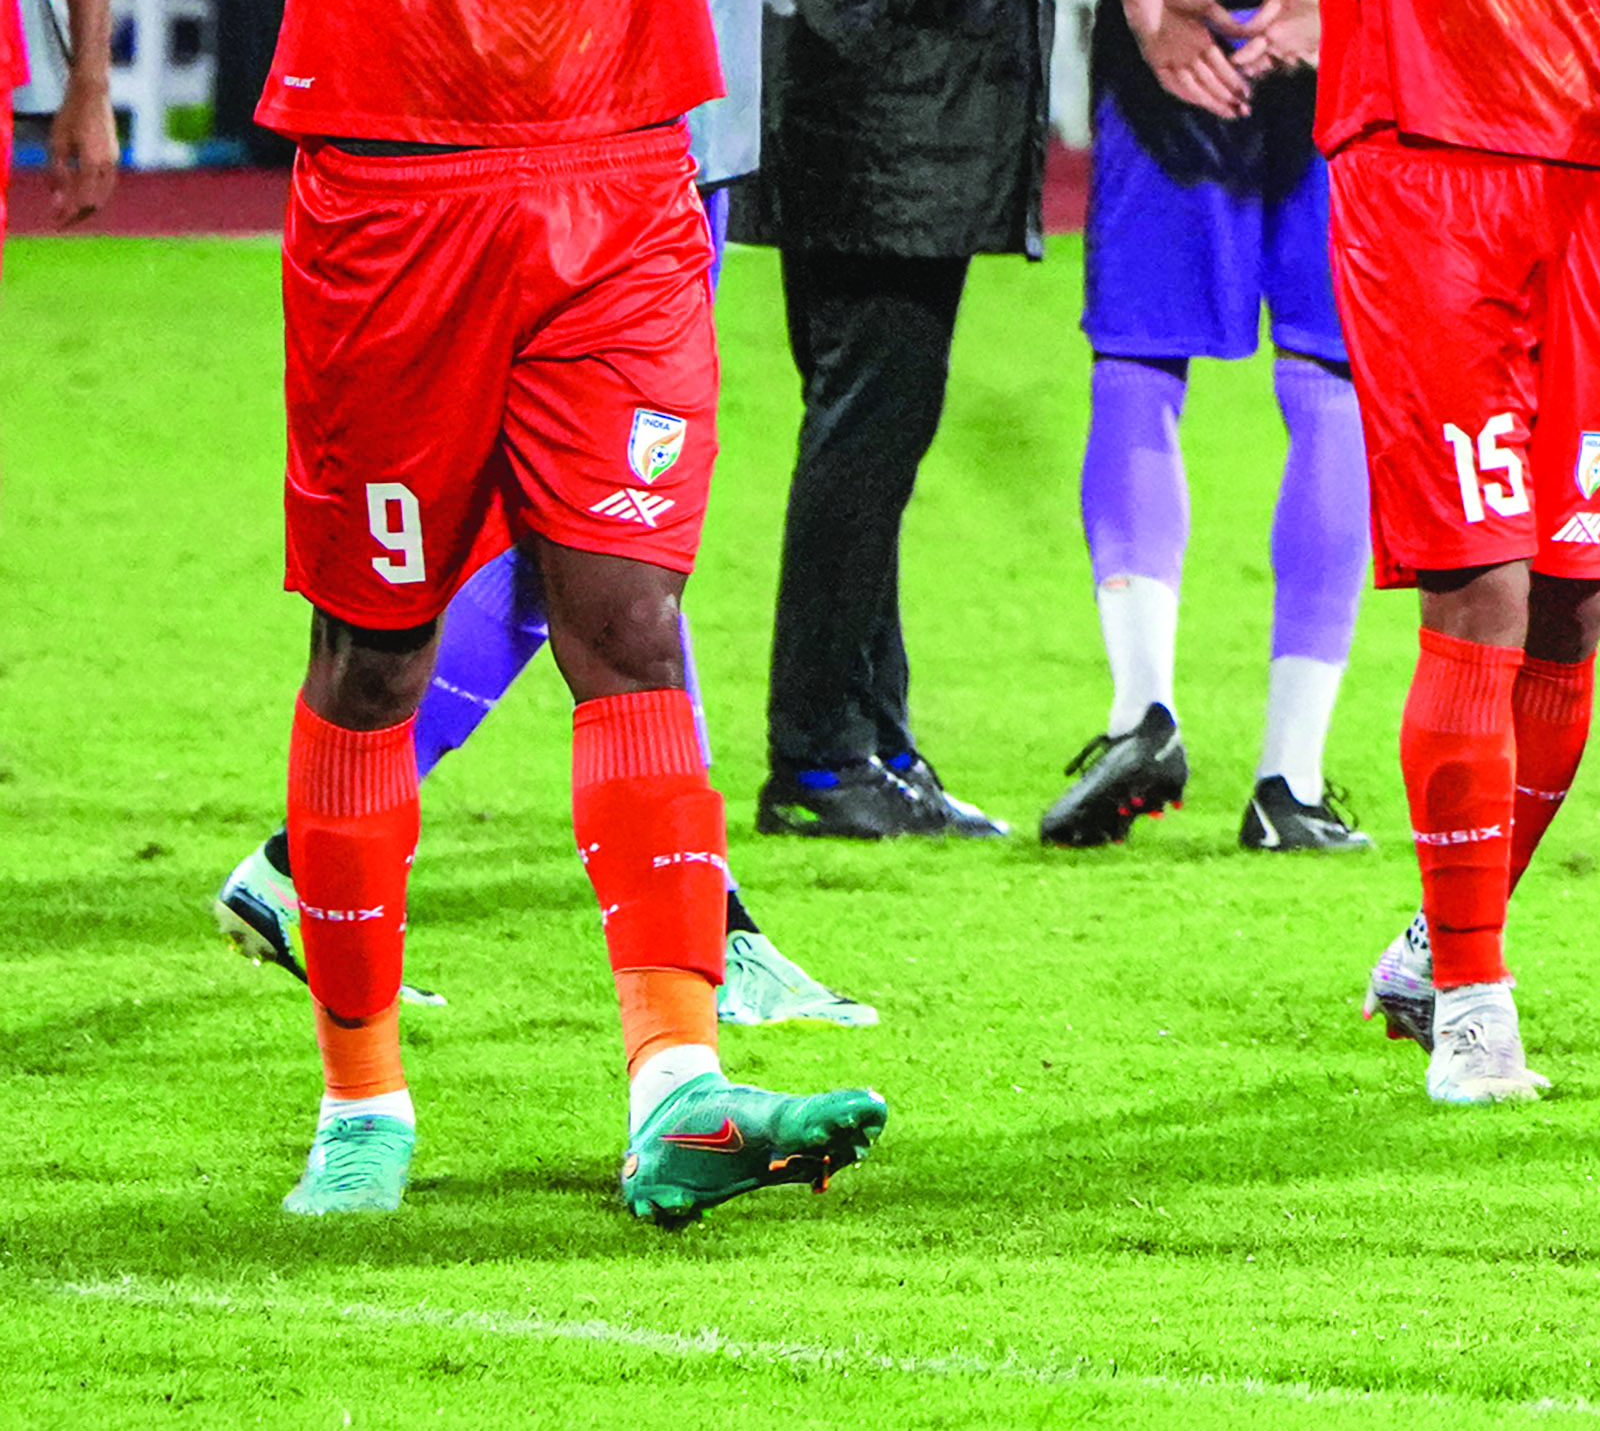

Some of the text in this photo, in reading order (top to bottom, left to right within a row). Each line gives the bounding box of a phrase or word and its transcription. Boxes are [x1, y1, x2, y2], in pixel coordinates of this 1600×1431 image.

[642, 418, 670, 431] INDIA
[1443, 412, 1530, 524] 15
[366, 482, 426, 584] 9
